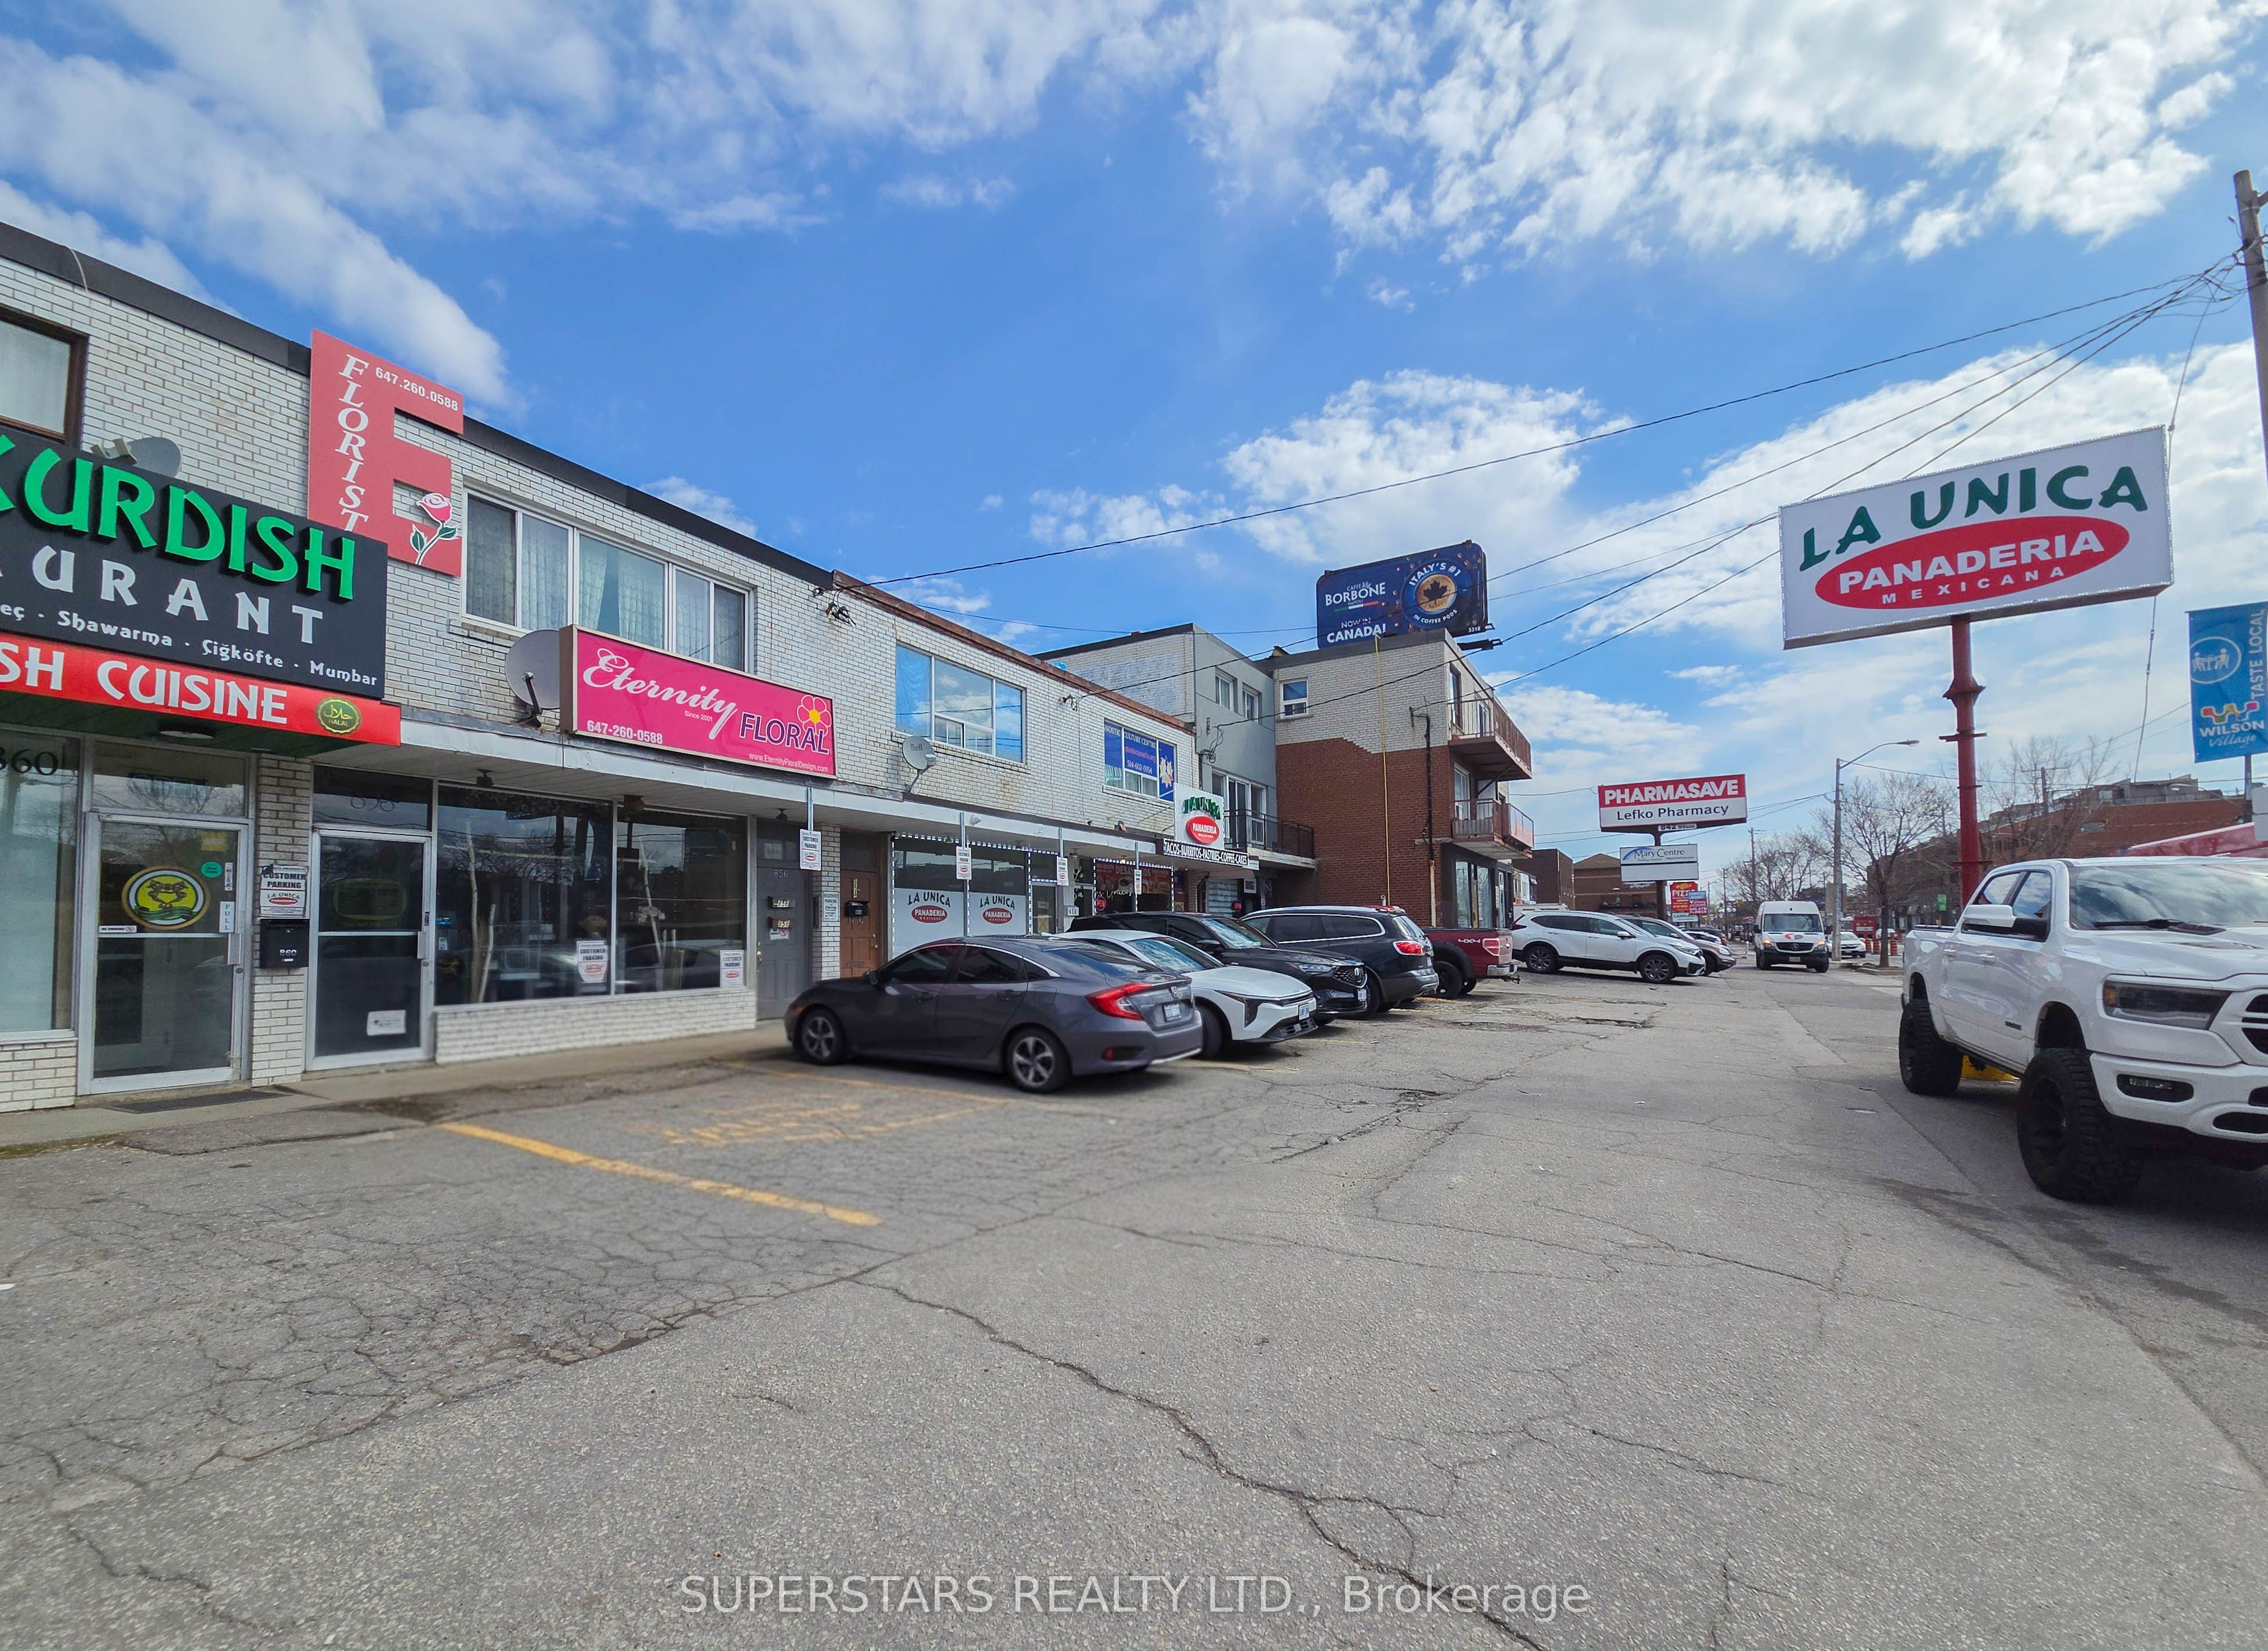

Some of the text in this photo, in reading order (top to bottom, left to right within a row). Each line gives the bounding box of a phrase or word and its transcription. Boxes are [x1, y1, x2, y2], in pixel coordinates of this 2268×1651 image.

[375, 366, 459, 411] 647.260.0588
[335, 354, 369, 532] FLORIST
[1799, 465, 2148, 571] LA UNICA
[1839, 530, 2105, 595] PANADERIA
[1408, 562, 1461, 586] ITALY'S #1
[0, 545, 323, 644] URANT
[1325, 582, 1386, 606] BORBONE
[1882, 567, 2064, 604] MEXICANA
[1341, 619, 1361, 629] NOW
[1443, 608, 1458, 621] PODS
[2249, 609, 2265, 654] LOCAL
[57, 610, 173, 647] Shawarma
[310, 660, 378, 686] Mumbar
[2249, 659, 2265, 700] TASTE
[97, 660, 288, 725] CUISINE
[583, 648, 738, 740] Eternity
[684, 710, 713, 722] Since 2001
[586, 719, 664, 745] 647-260-0588
[738, 711, 830, 755] FLORAL
[2199, 720, 2265, 737] WILSON
[1141, 738, 1156, 749] CENTRE
[2209, 734, 2257, 748] Village
[749, 753, 829, 773] www.EternityFloralDesign.com
[1604, 779, 1739, 805] PHARMASAVE
[1617, 805, 1729, 821] Lefko Pharmacy
[1192, 823, 1217, 835] PANADERIA
[1634, 848, 1685, 859] Mary Centre
[263, 872, 307, 880] CUSTOMER
[774, 868, 788, 878] 856
[267, 881, 302, 889] PARKING
[908, 892, 951, 908] LA UNICA
[979, 895, 1016, 910] LA UNICA
[914, 908, 945, 917] PANADERIA
